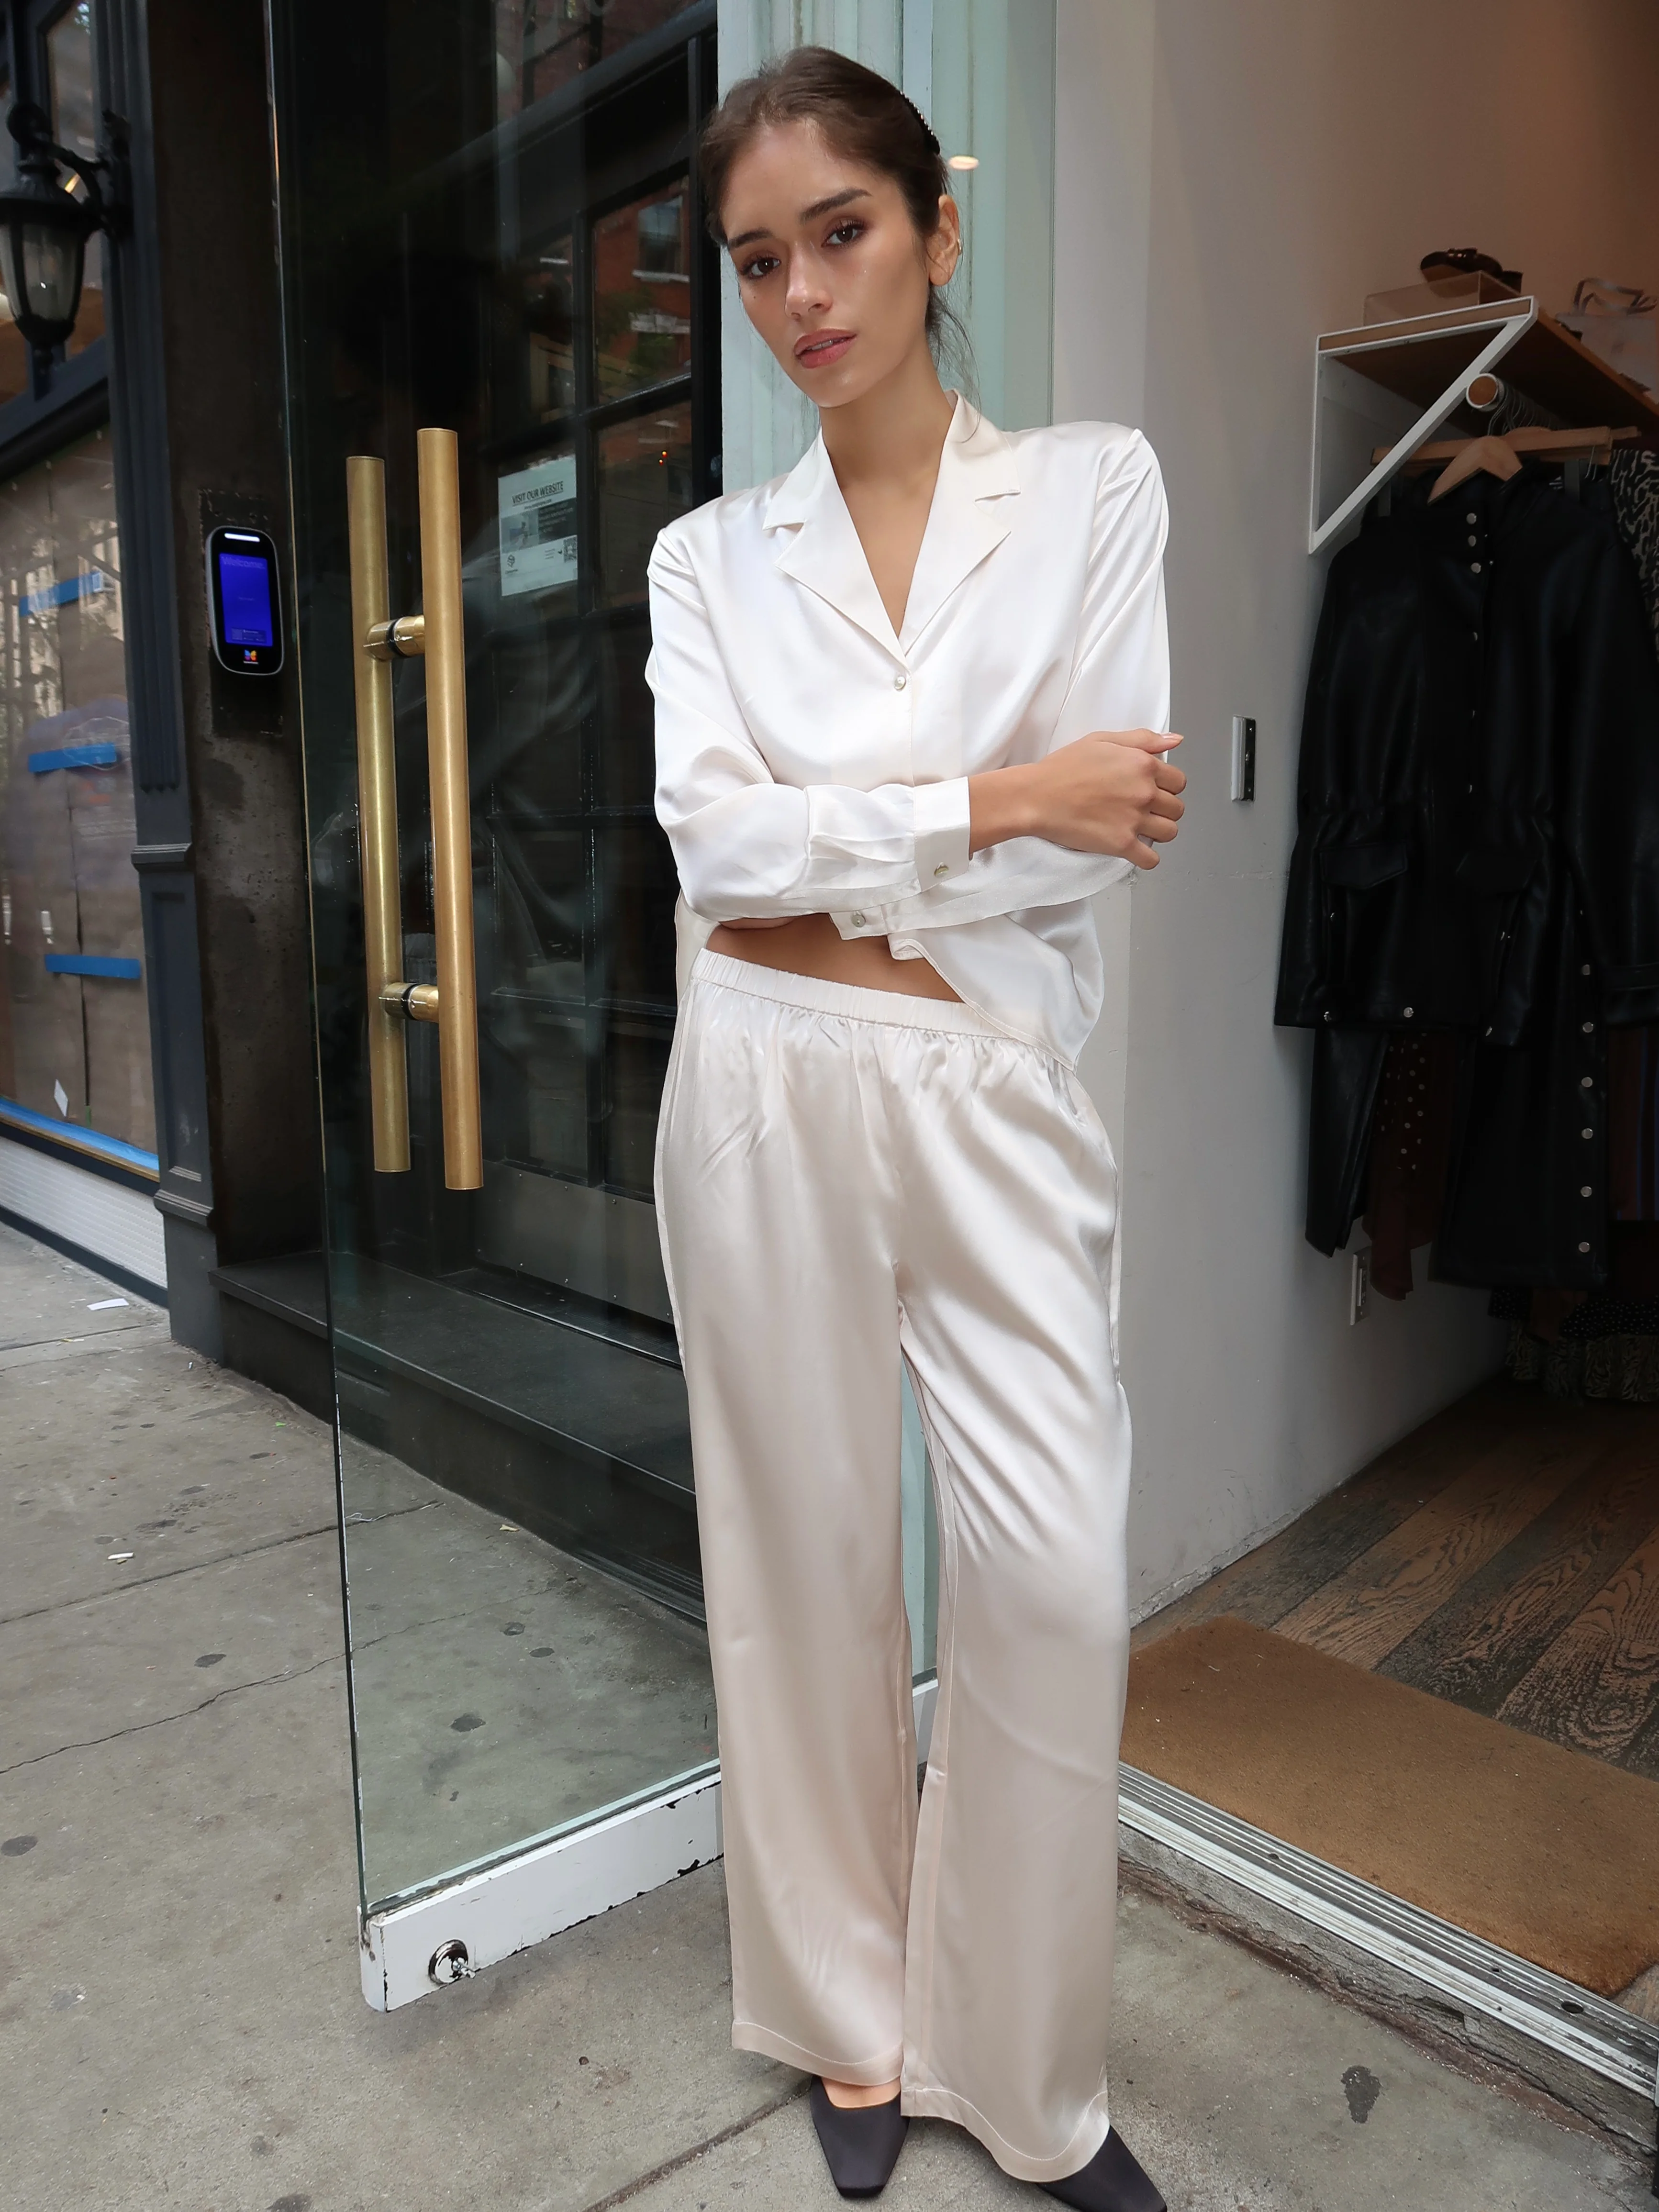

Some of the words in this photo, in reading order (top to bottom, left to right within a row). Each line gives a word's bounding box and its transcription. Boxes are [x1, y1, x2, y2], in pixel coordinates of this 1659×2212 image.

[512, 494, 527, 504] VISIT
[526, 489, 539, 500] OUR
[539, 481, 564, 496] WEBSITE
